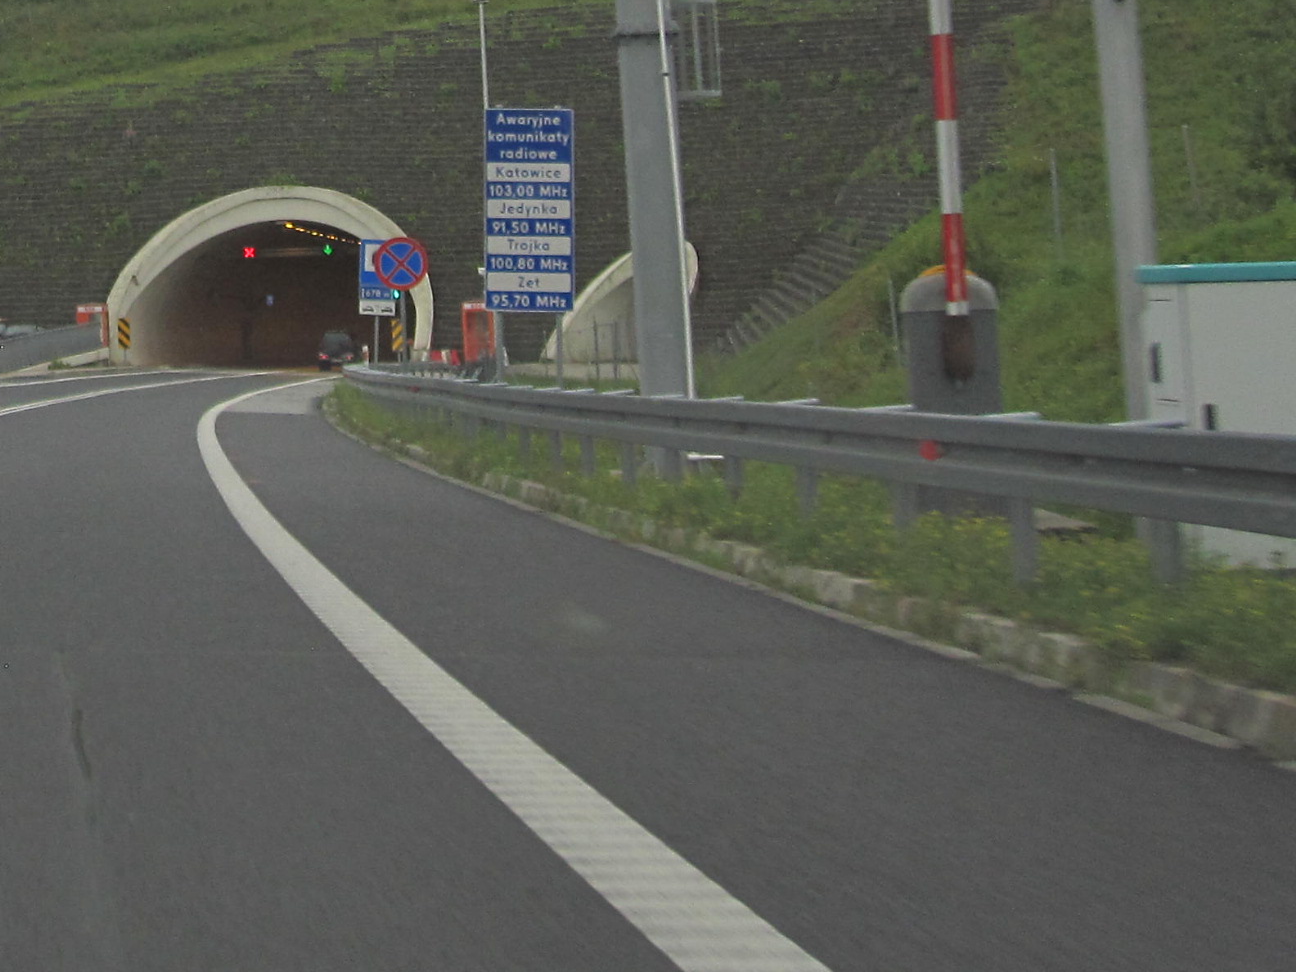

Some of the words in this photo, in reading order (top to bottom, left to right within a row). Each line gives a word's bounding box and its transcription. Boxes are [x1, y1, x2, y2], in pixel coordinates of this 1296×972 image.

[496, 113, 561, 128] Awaryjne
[487, 130, 570, 146] komunikaty
[500, 147, 558, 160] radiowe
[495, 166, 561, 179] Katowice
[539, 184, 568, 198] MHz
[499, 202, 558, 217] Jedynka
[535, 221, 566, 234] MHz
[540, 258, 569, 271] MHz
[517, 275, 540, 288] Zet
[536, 295, 567, 308] MHz
